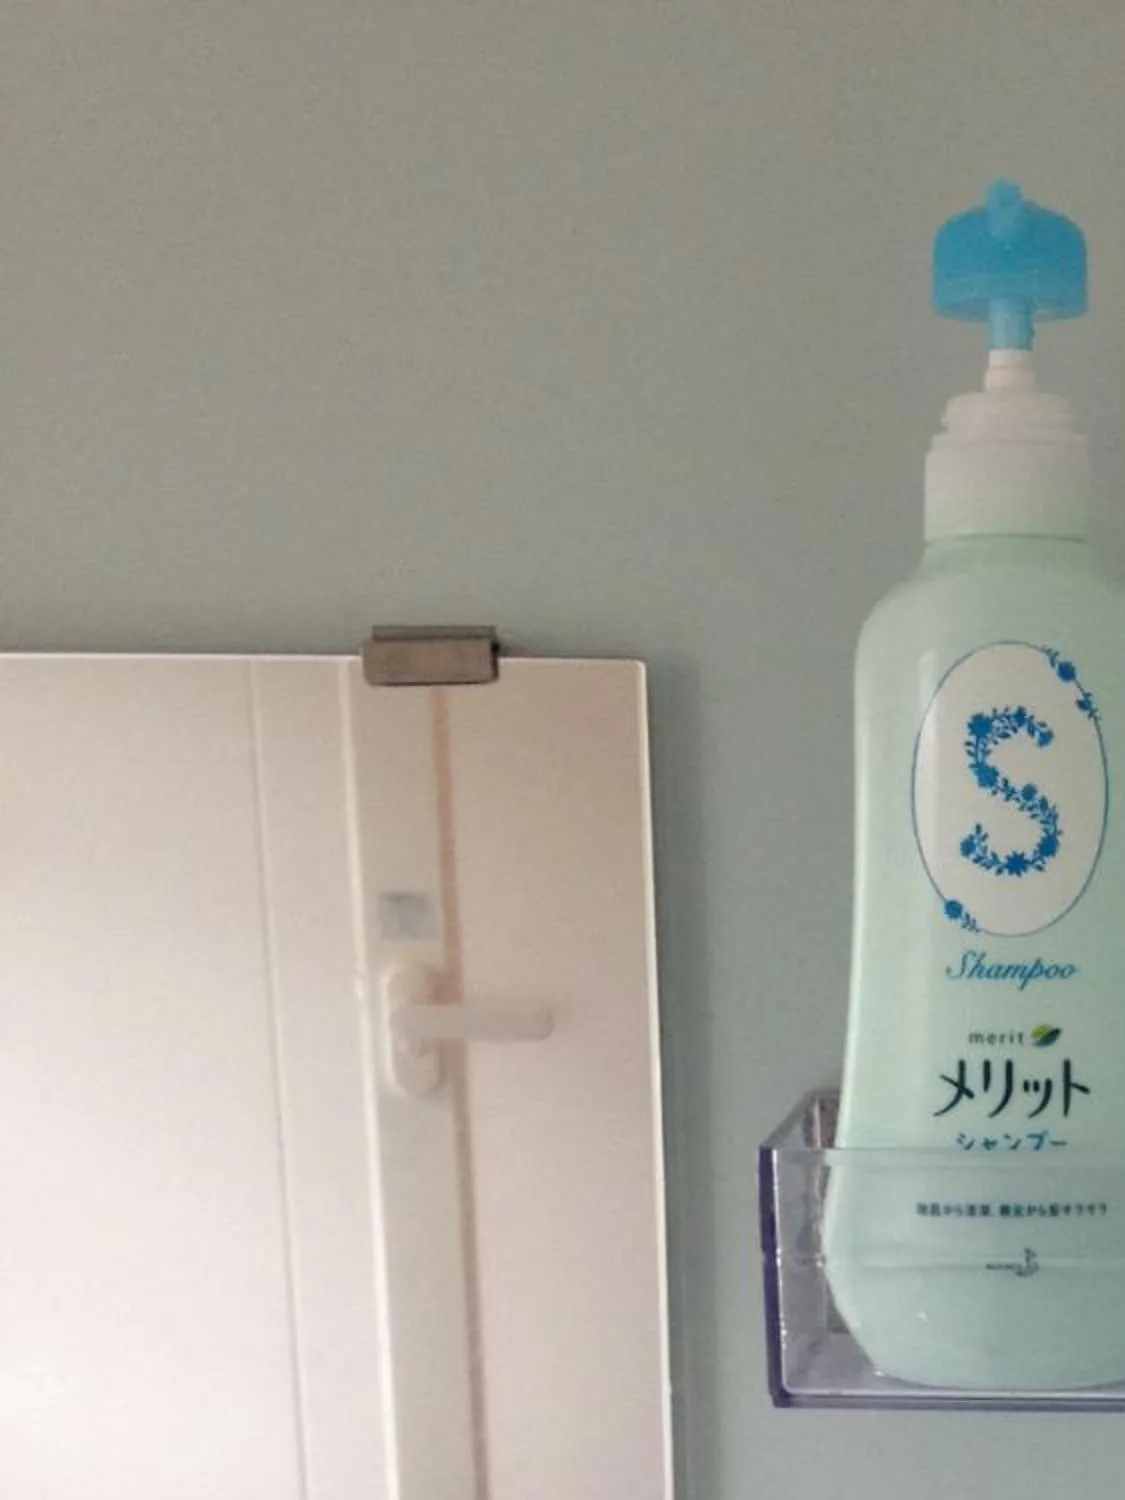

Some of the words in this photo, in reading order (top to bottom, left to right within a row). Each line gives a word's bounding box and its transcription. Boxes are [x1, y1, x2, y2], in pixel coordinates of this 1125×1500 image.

[959, 705, 1063, 878] S
[945, 949, 1077, 991] Shampoo
[968, 1030, 1025, 1046] merit
[932, 1058, 1091, 1119] メリット
